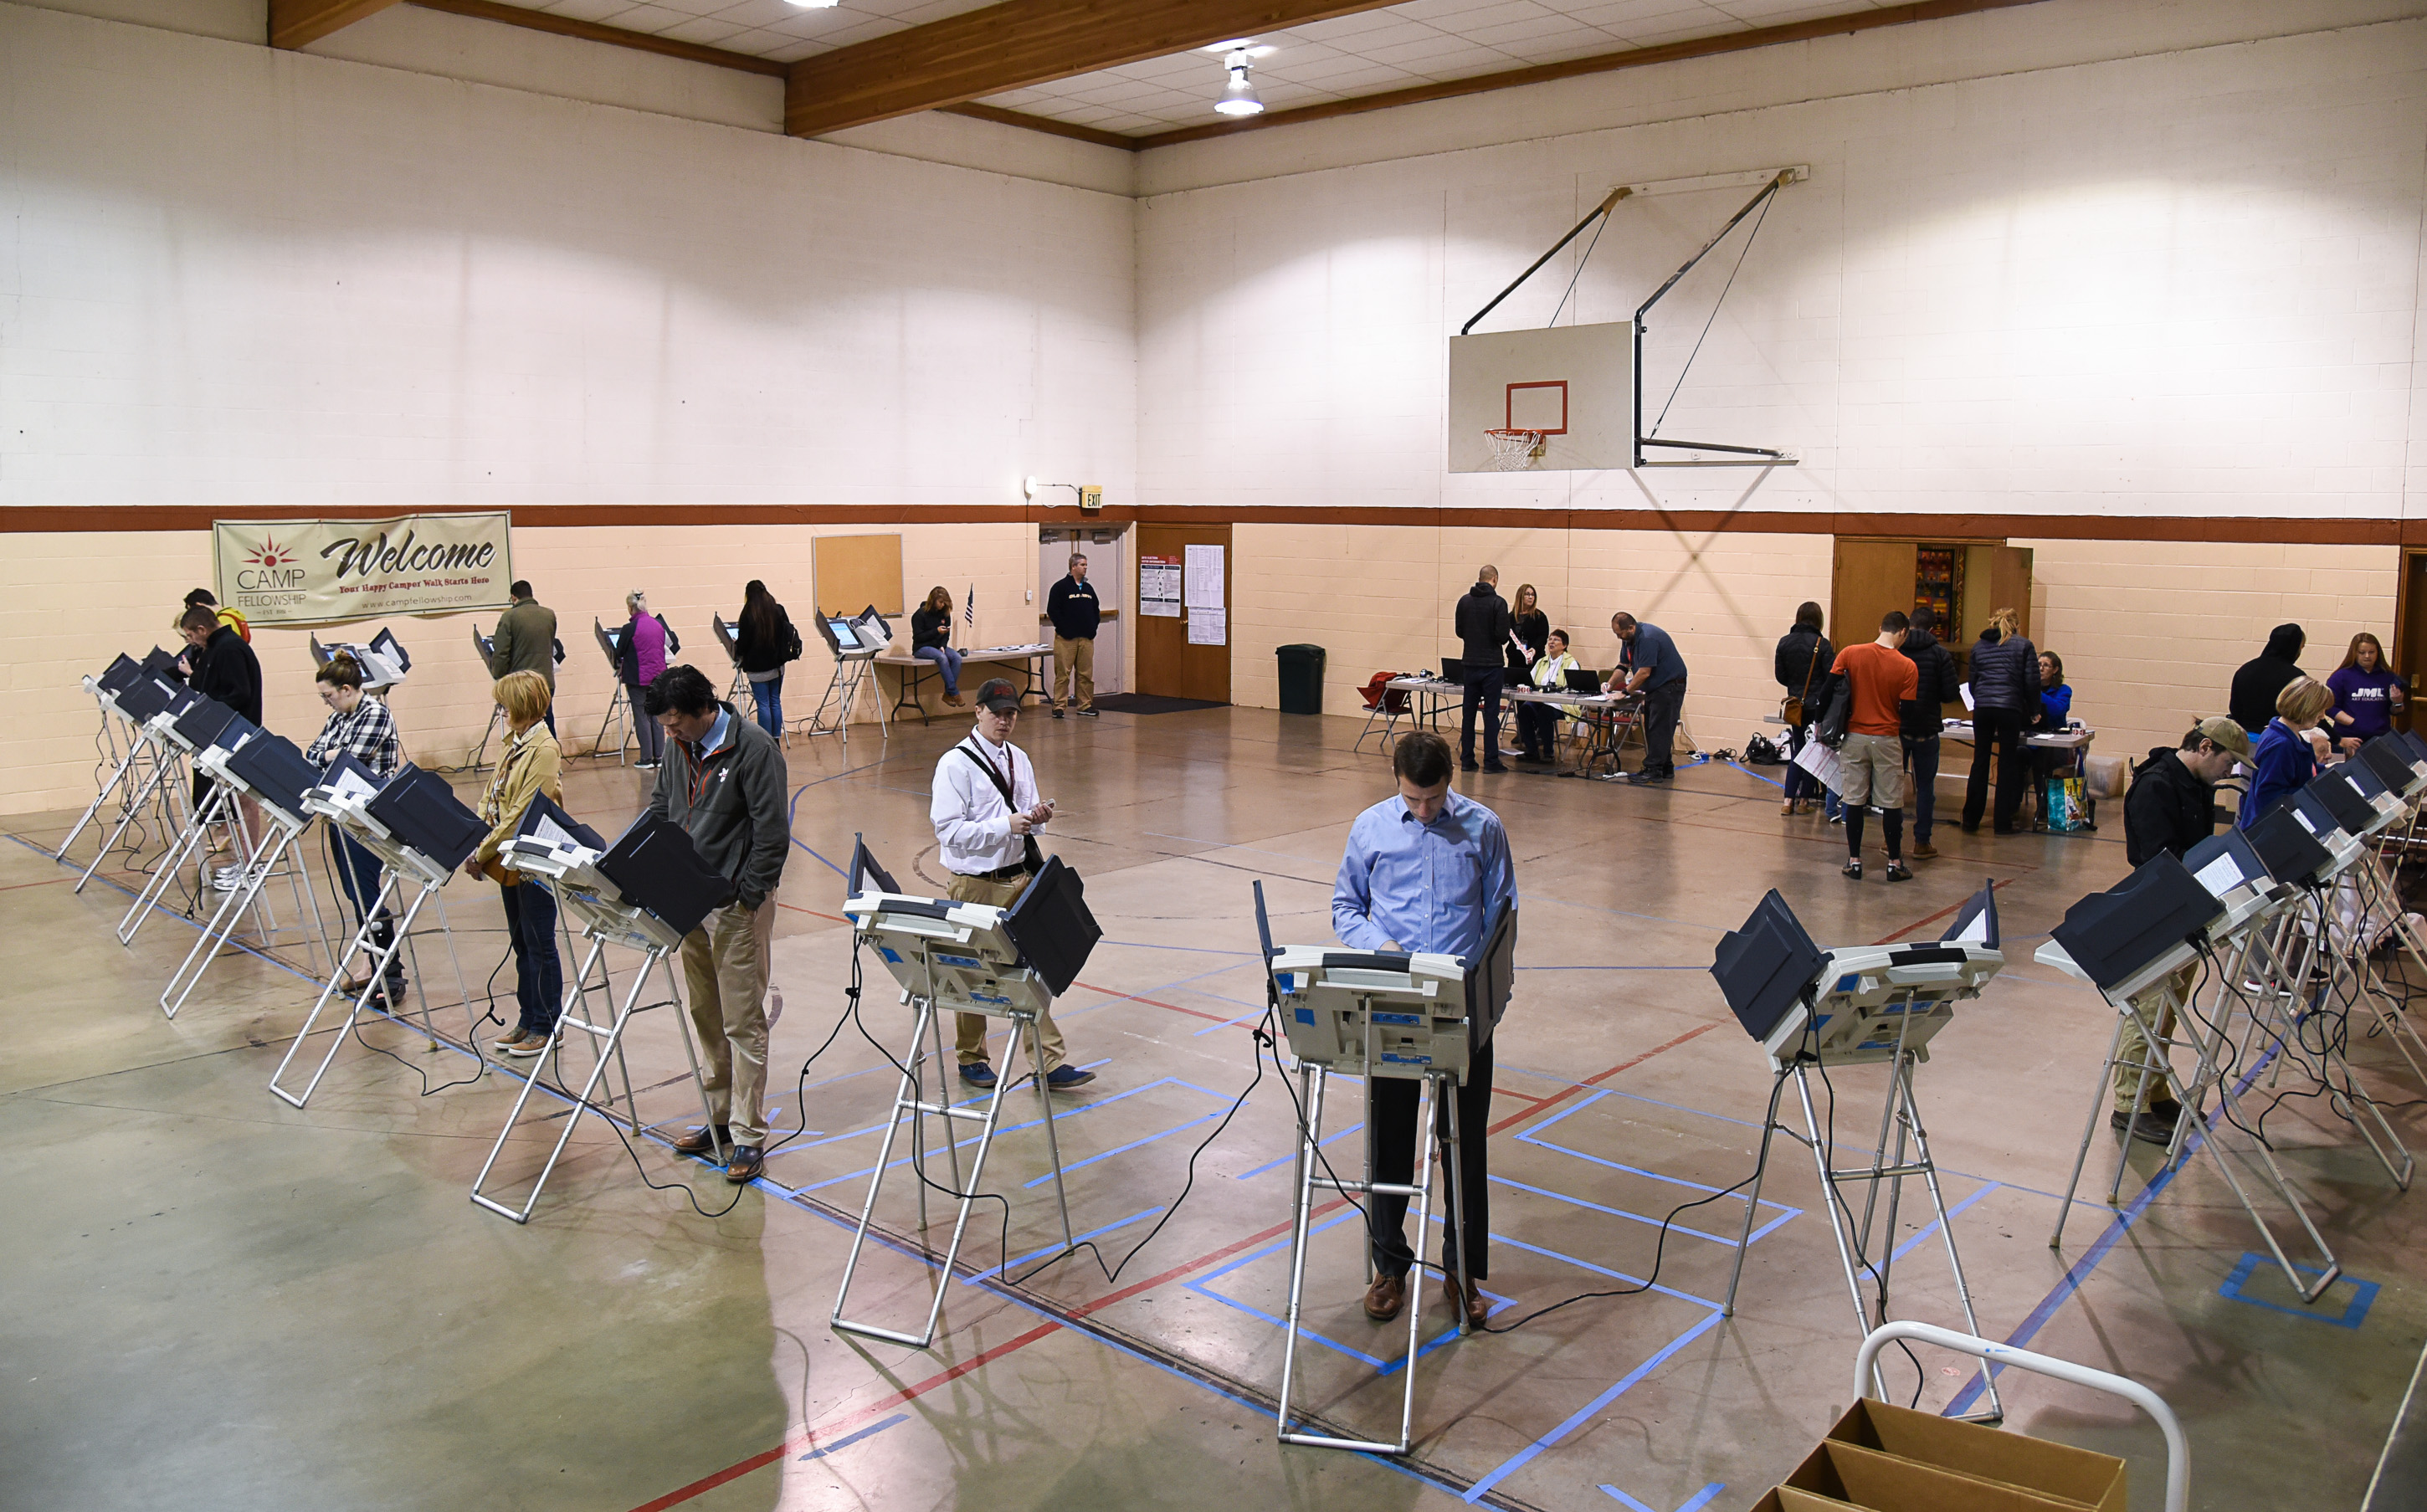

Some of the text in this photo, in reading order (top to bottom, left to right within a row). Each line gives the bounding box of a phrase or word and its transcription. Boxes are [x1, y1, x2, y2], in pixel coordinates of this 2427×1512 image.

[1088, 494, 1101, 506] EXIT
[320, 530, 497, 579] Welcome
[237, 569, 305, 590] CAMP
[362, 583, 387, 593] Happy
[388, 581, 422, 590] Camper
[444, 577, 469, 586] Starts
[238, 593, 306, 607] FELLOWSHIP
